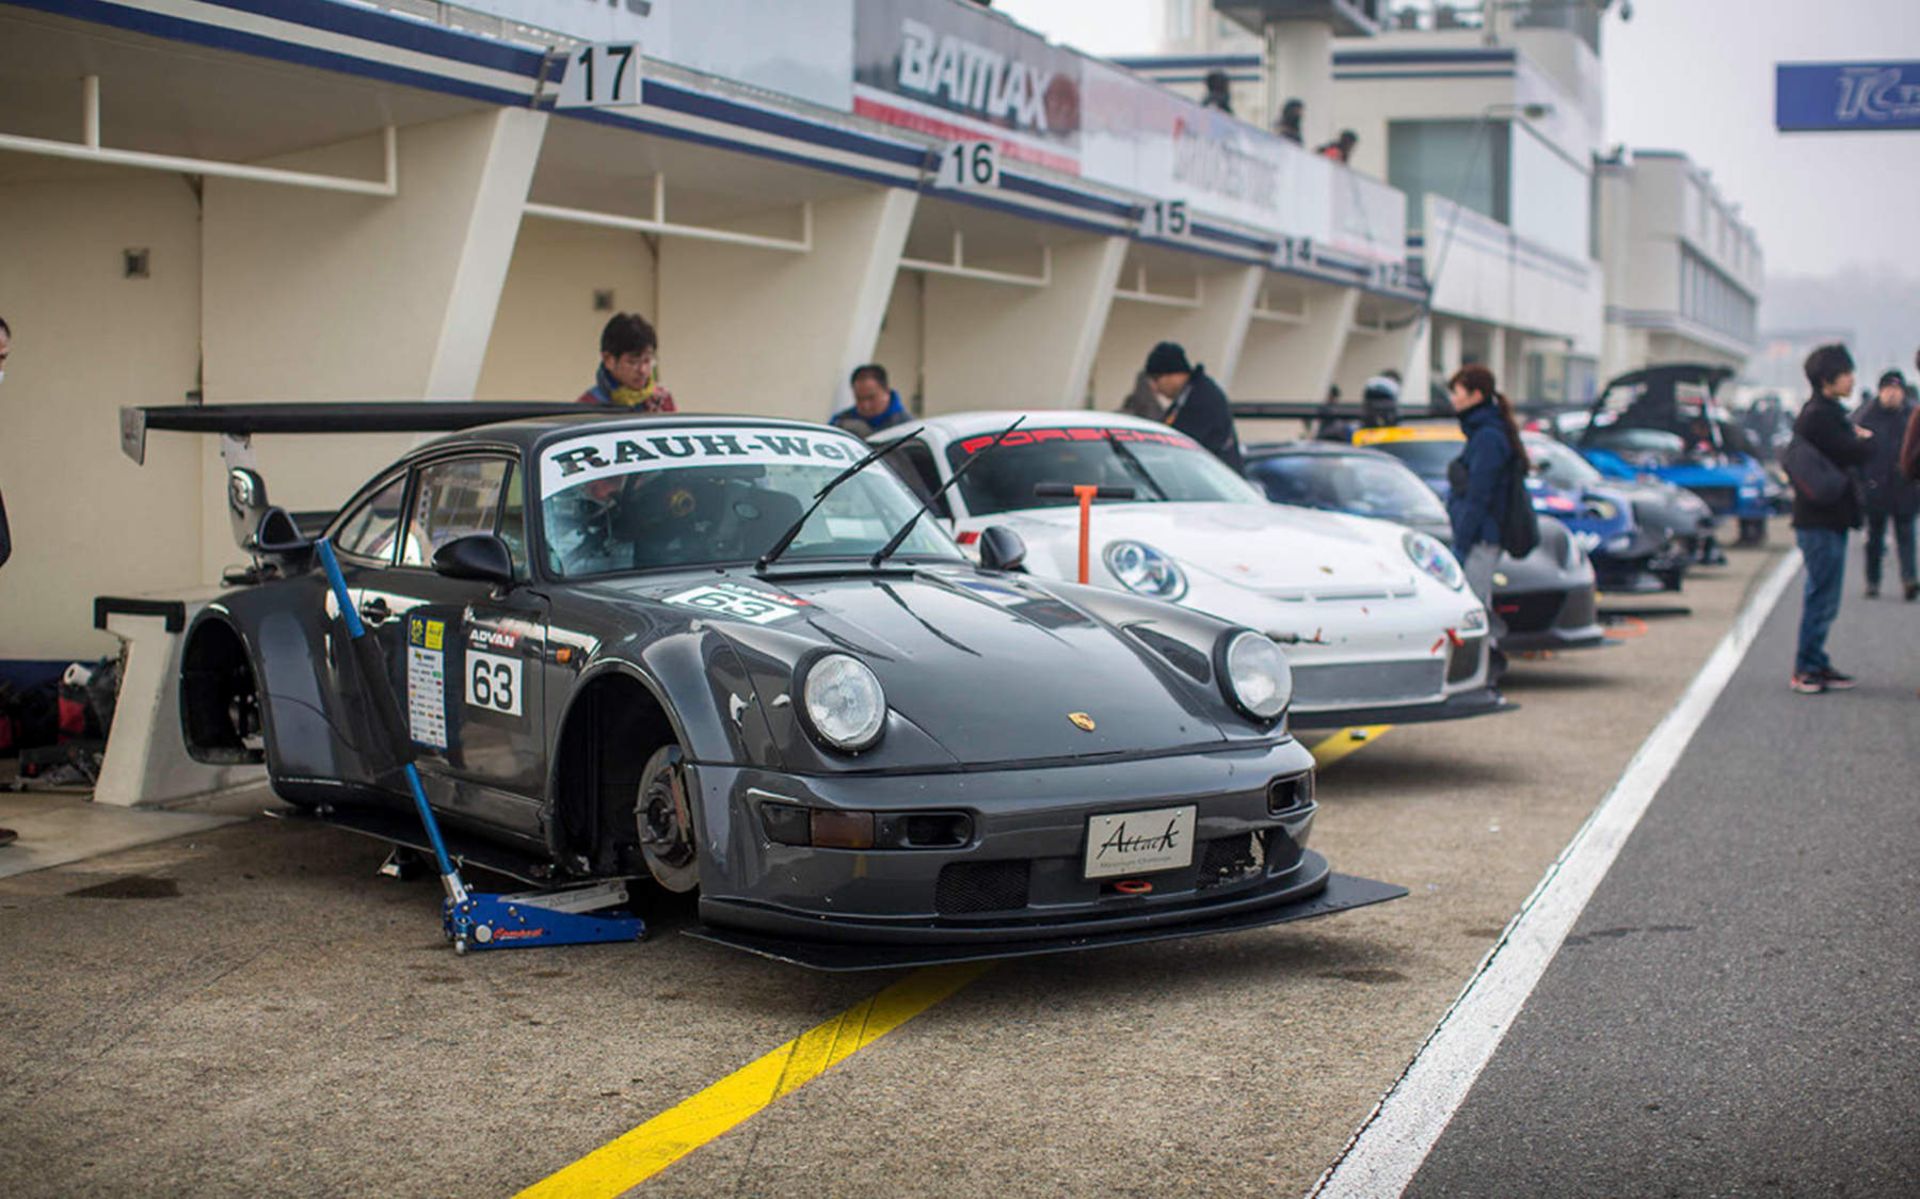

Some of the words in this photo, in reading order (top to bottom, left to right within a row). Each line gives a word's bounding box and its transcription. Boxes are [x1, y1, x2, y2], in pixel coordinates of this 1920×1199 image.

[579, 46, 633, 102] 17
[953, 142, 994, 184] 16
[1154, 202, 1186, 234] 15
[1284, 236, 1313, 264] 14
[687, 592, 776, 617] 63
[469, 629, 516, 649] ADVAN
[473, 659, 514, 711] 63
[1096, 818, 1180, 861] Attack
